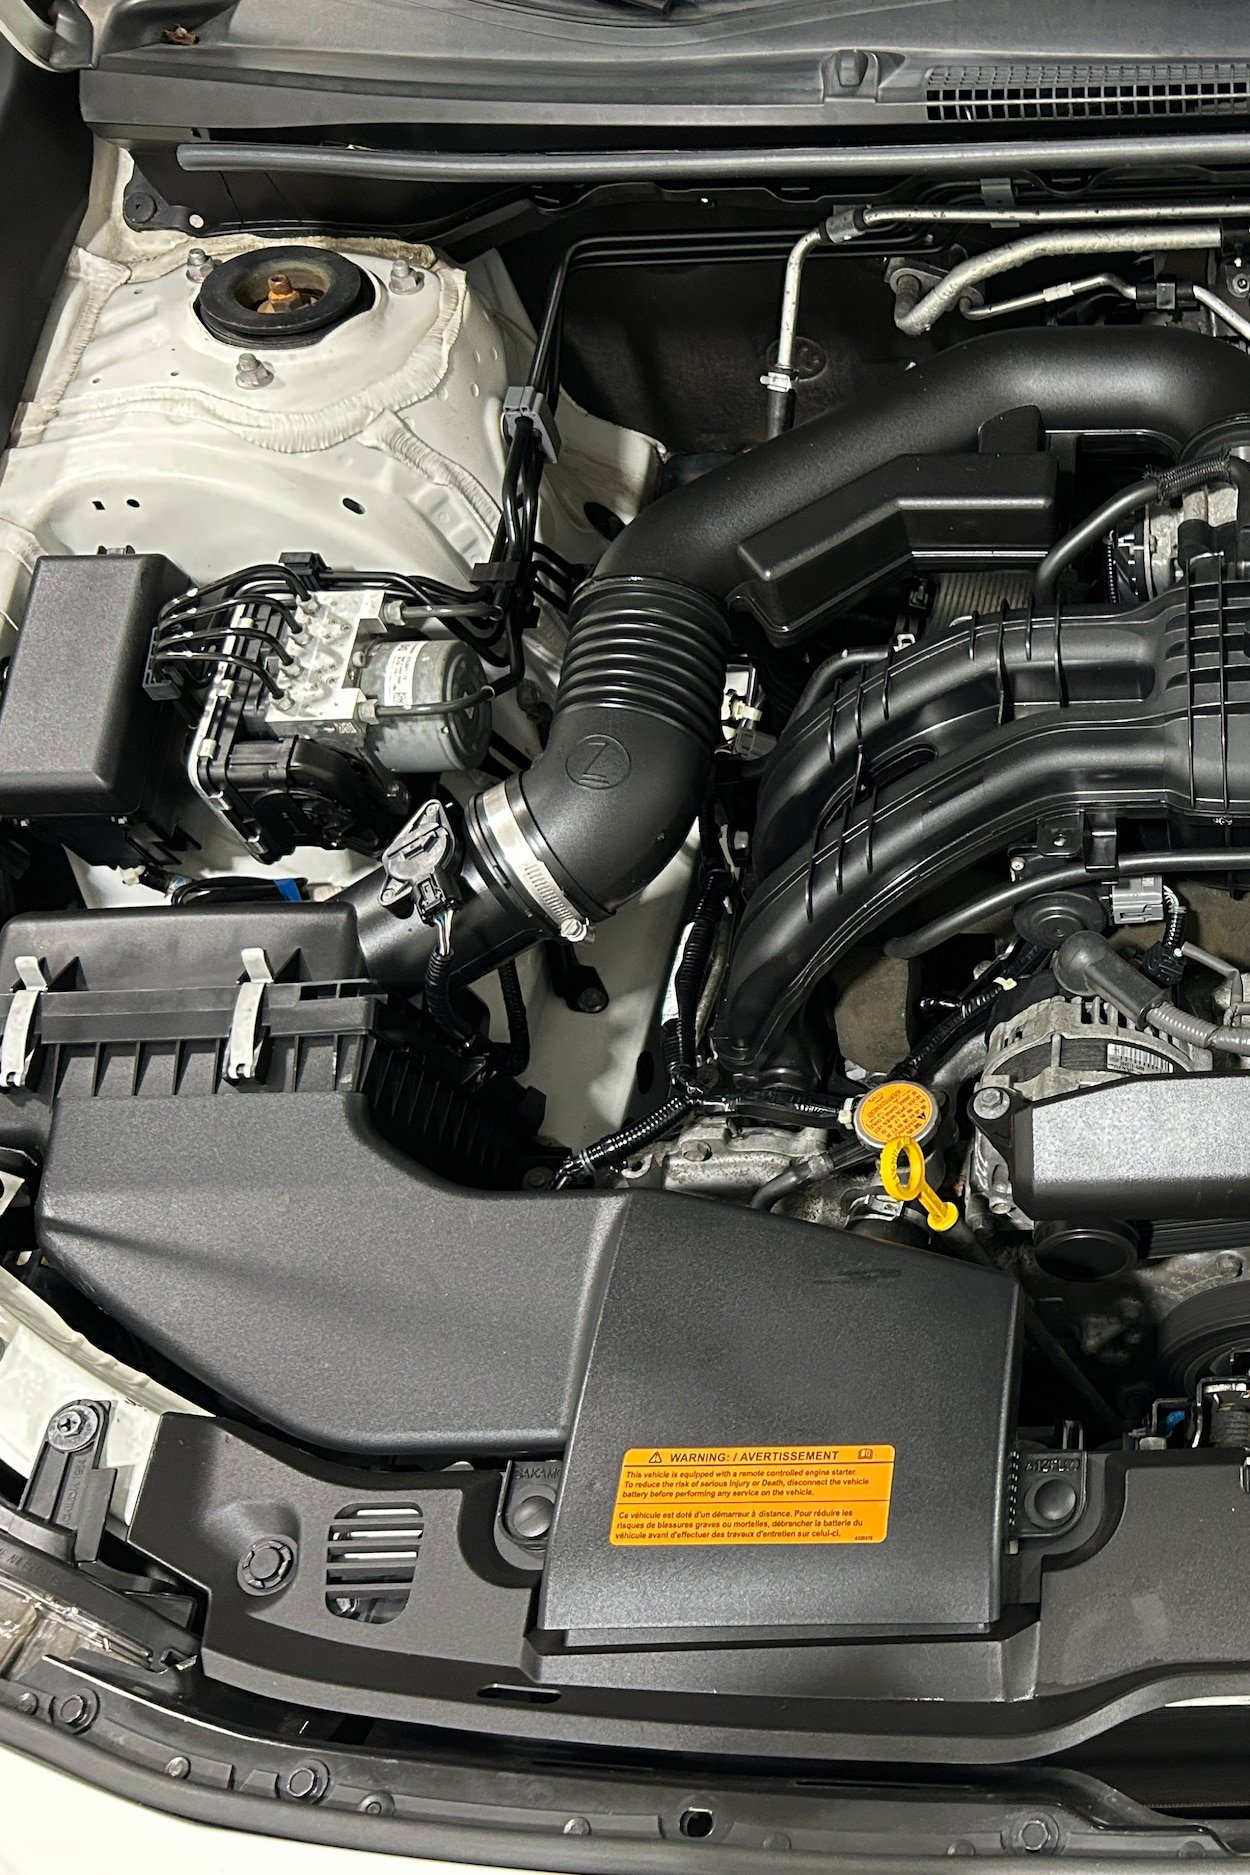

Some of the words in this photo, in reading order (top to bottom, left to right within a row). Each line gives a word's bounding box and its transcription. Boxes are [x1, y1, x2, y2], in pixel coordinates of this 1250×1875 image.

[670, 1452, 730, 1463] WARNING:
[740, 1450, 839, 1462] AVERTISSEMENT
[680, 1470, 714, 1479] equipped
[766, 1469, 804, 1477] controlled
[805, 1469, 830, 1477] engine
[761, 1479, 785, 1487] Death,
[622, 1491, 648, 1499] battery
[675, 1490, 716, 1498] performing
[717, 1490, 731, 1498] any
[711, 1510, 750, 1518] démarreur
[794, 1509, 812, 1517] Pour
[813, 1509, 840, 1517] réduire
[616, 1522, 645, 1530] risques
[646, 1521, 656, 1529] de
[657, 1521, 694, 1529] blessures
[695, 1521, 720, 1529] graves
[733, 1520, 770, 1528] mortelles,
[814, 1519, 821, 1527] la
[823, 1519, 851, 1527] batterie
[616, 1531, 646, 1539] véhicule
[648, 1531, 669, 1539] avant
[670, 1531, 710, 1539] d'effectuer
[756, 1530, 796, 1538] d'entretien
[811, 1529, 841, 1537] celui-ci.
